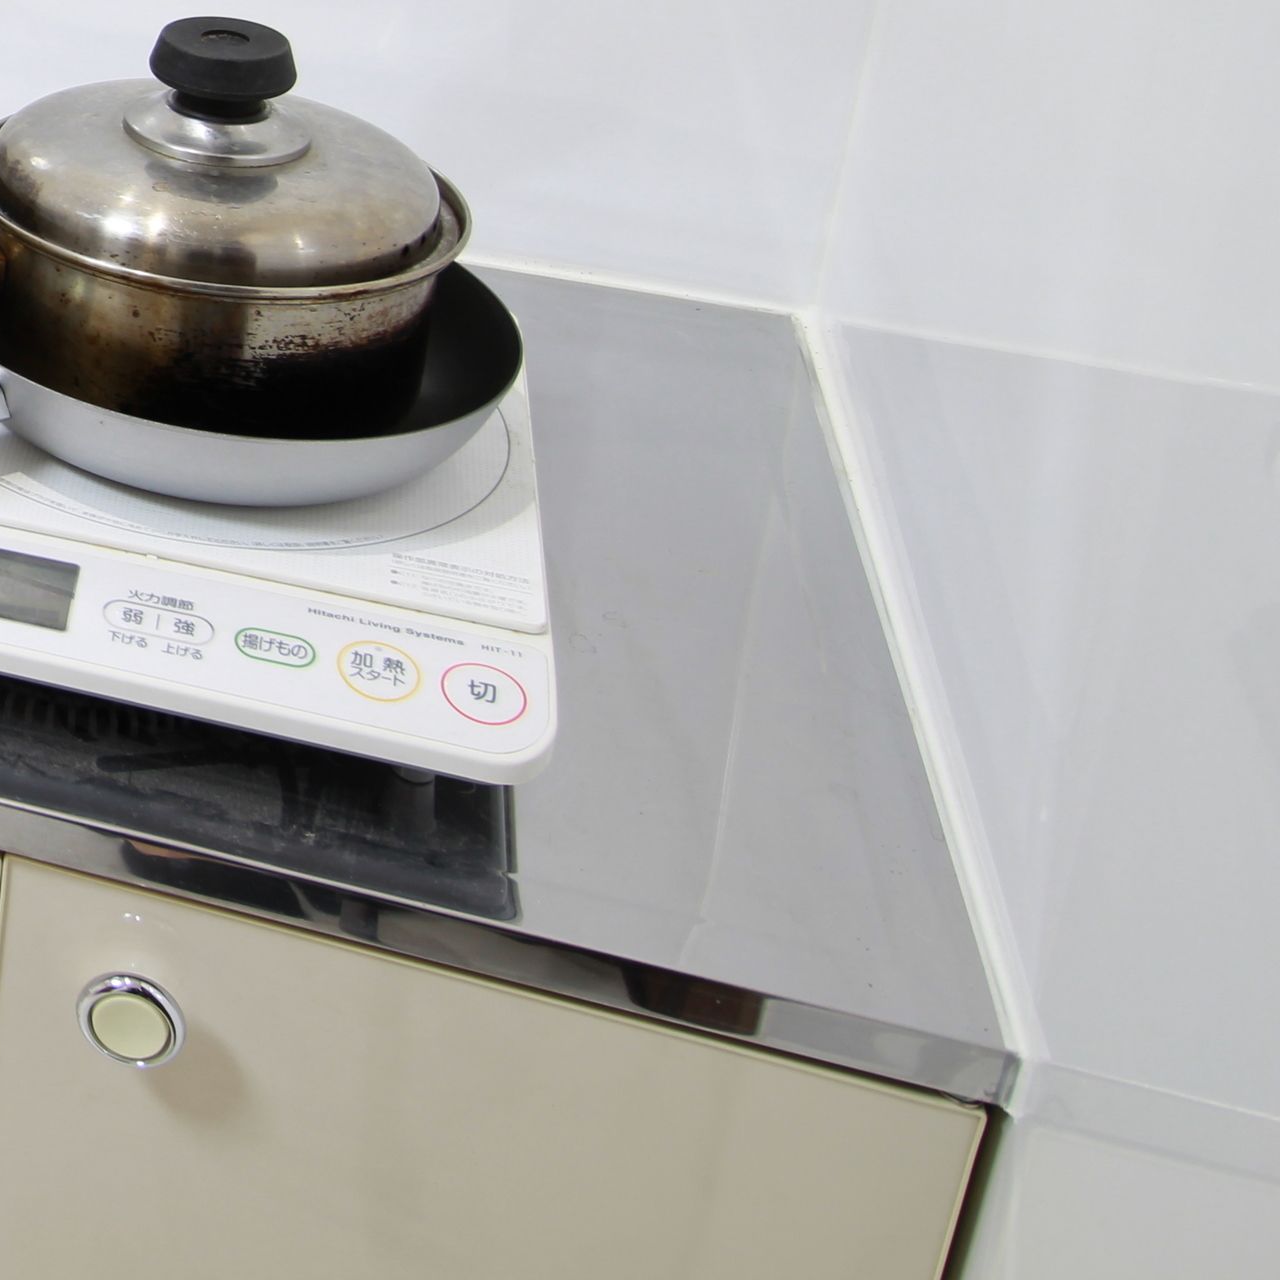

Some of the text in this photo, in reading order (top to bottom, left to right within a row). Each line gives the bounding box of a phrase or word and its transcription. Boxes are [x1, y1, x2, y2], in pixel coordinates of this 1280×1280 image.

[127, 589, 194, 611] 火力調節
[122, 607, 195, 637] 弱 強
[307, 607, 465, 646] Hitachi Living Systems
[108, 630, 203, 661] 下げる 上げる
[241, 632, 308, 660] 揚げもの
[350, 665, 406, 687] スタート
[468, 680, 497, 704] 切
